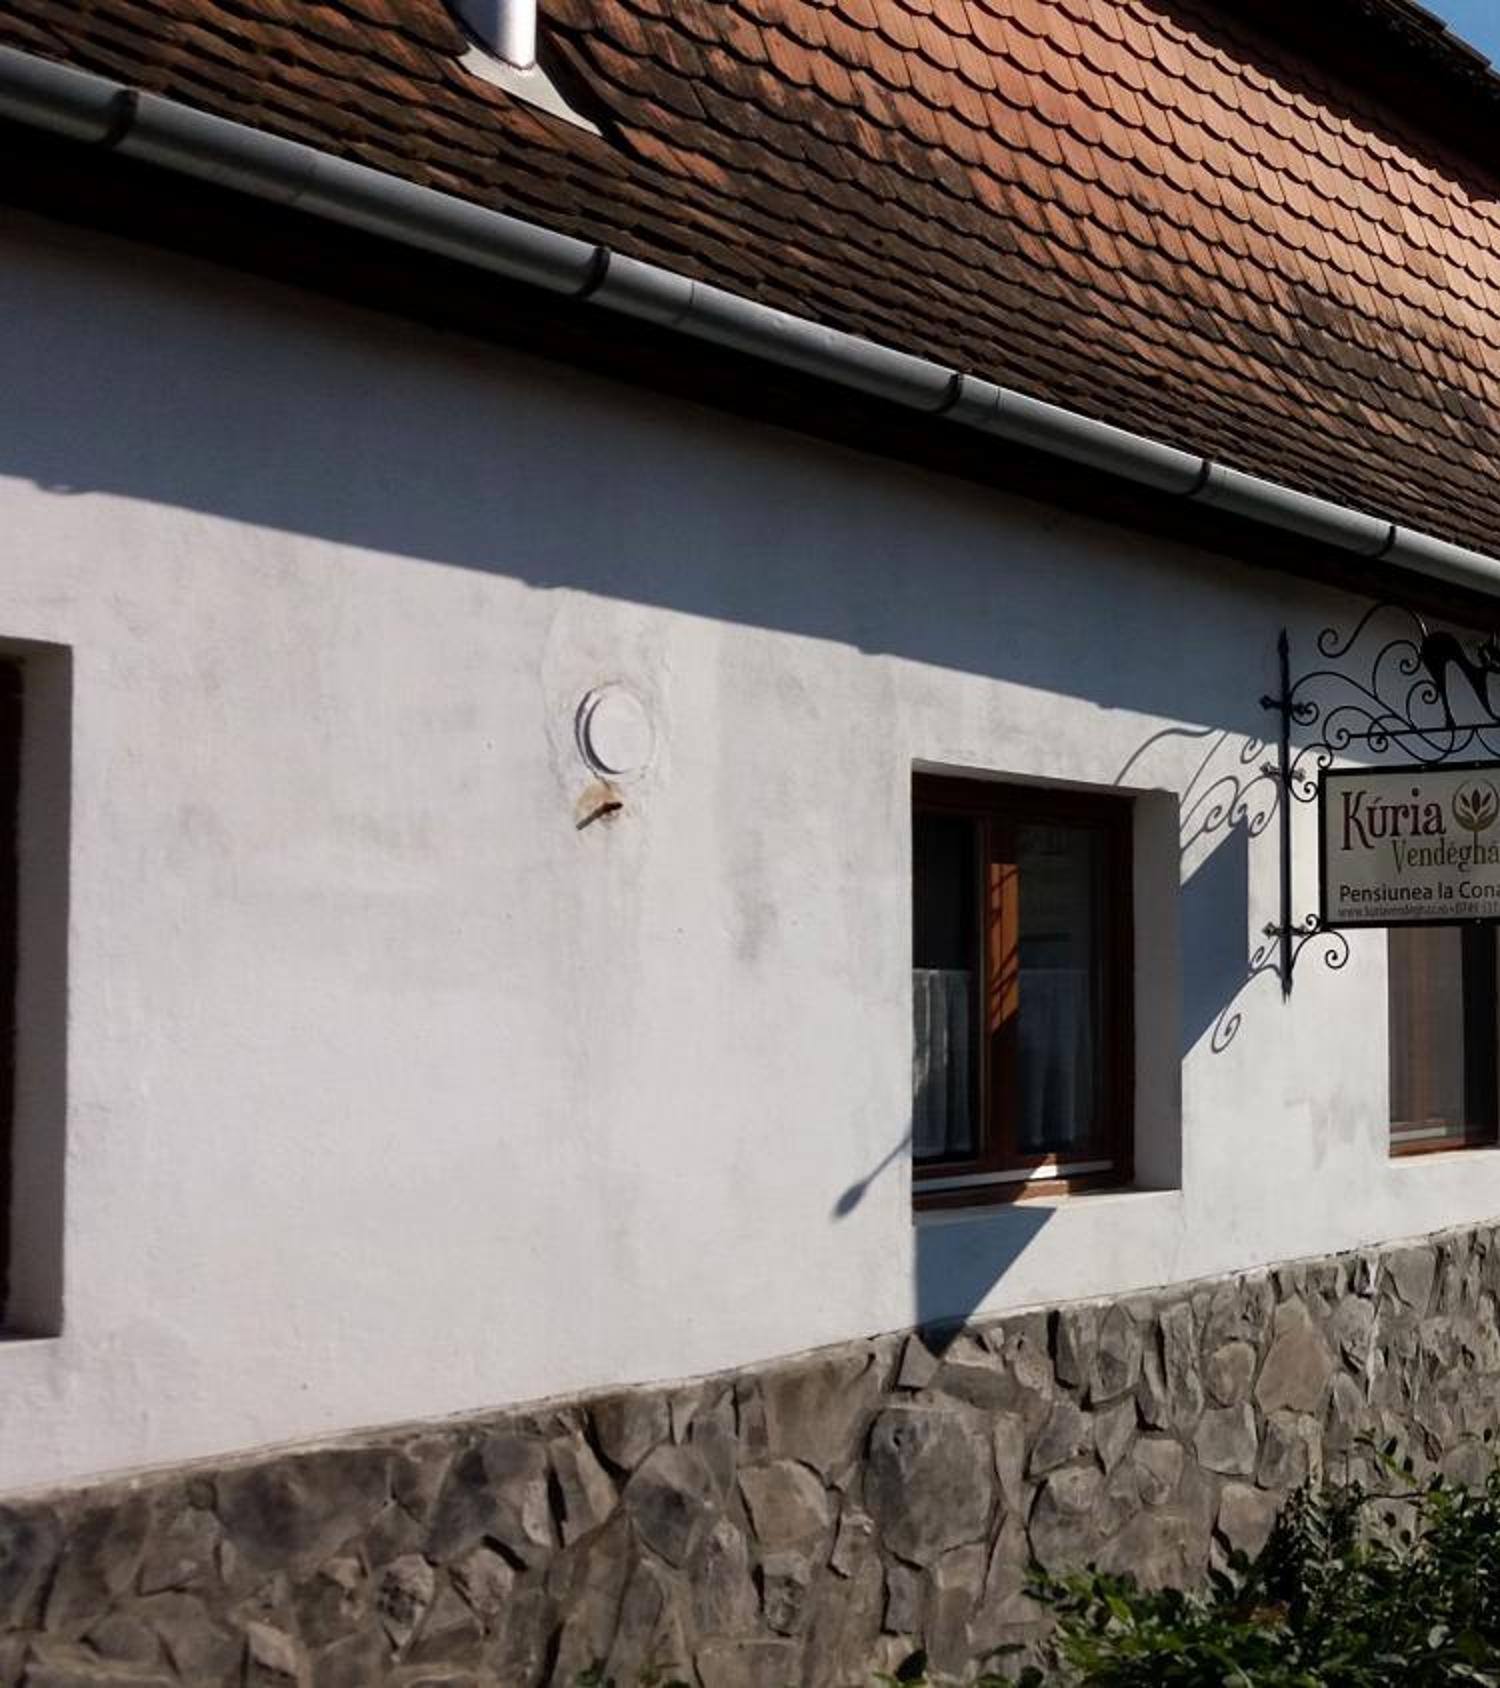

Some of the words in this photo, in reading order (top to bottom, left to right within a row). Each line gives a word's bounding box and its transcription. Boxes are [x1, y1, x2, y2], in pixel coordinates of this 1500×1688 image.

[1341, 787, 1447, 850] Kúria
[1340, 884, 1433, 902] Pensiunea
[1438, 882, 1453, 899] la
